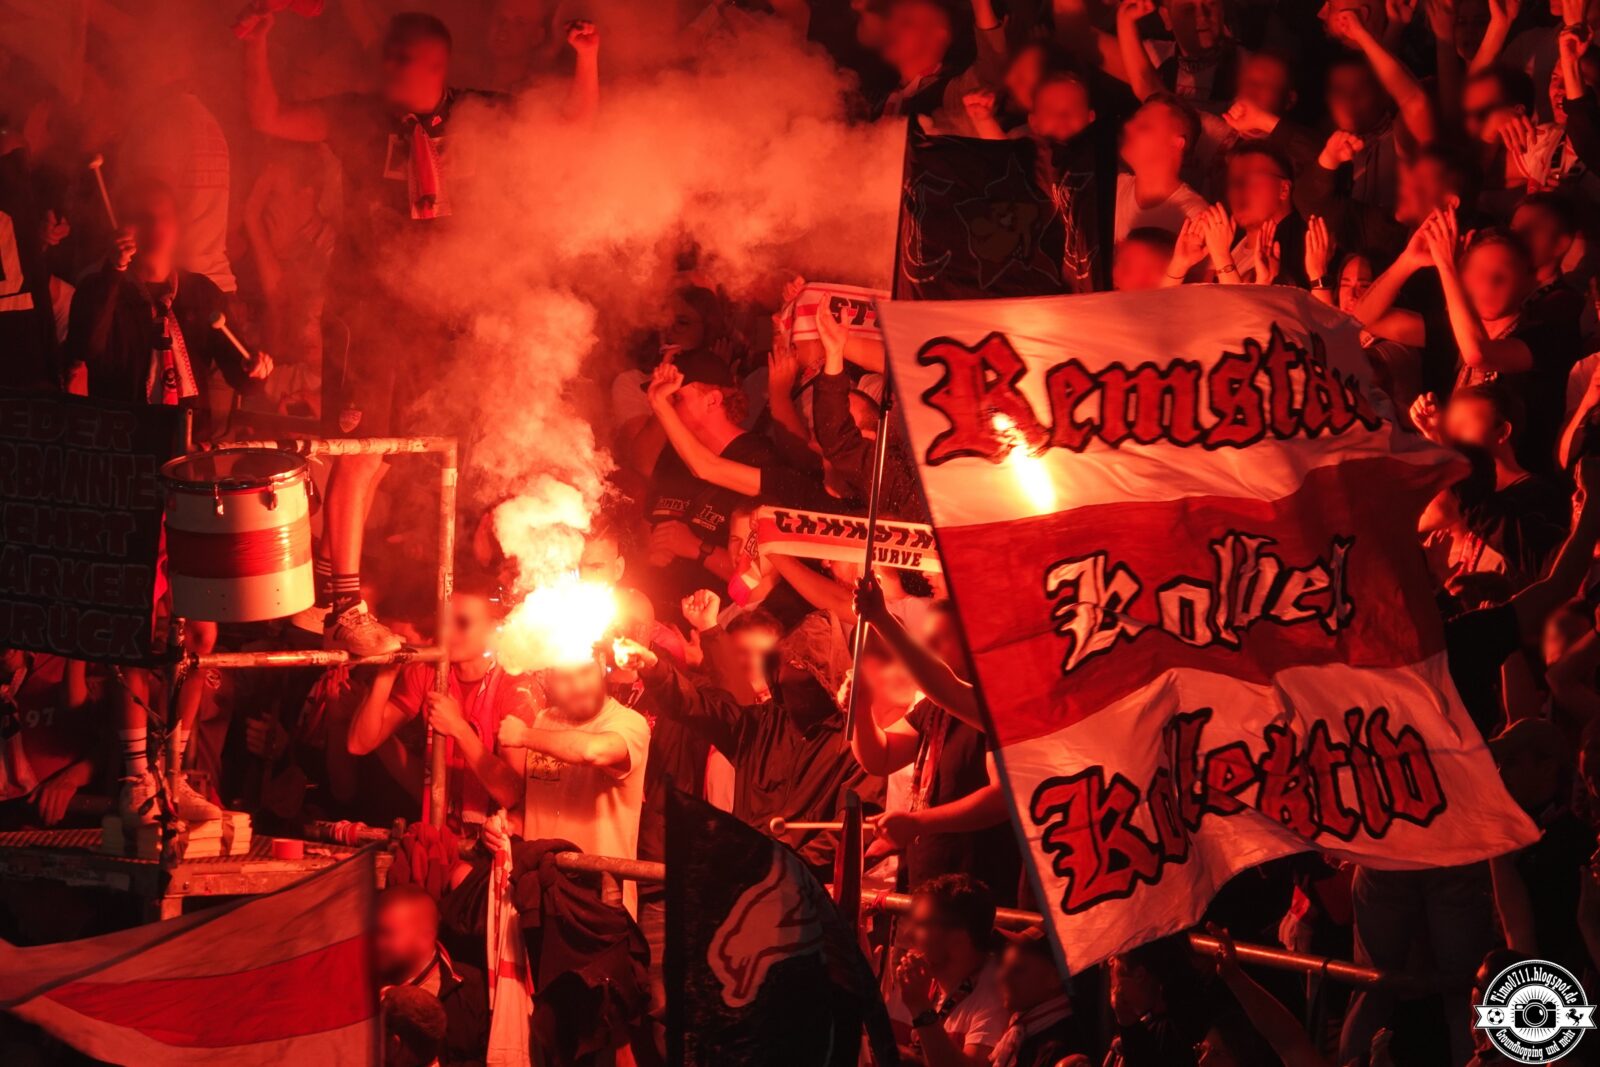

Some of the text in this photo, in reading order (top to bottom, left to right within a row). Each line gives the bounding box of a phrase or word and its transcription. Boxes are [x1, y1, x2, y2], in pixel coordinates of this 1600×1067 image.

[829, 295, 881, 329] ST
[774, 510, 939, 551] CANNSTA
[1045, 529, 1355, 674] Kolbel
